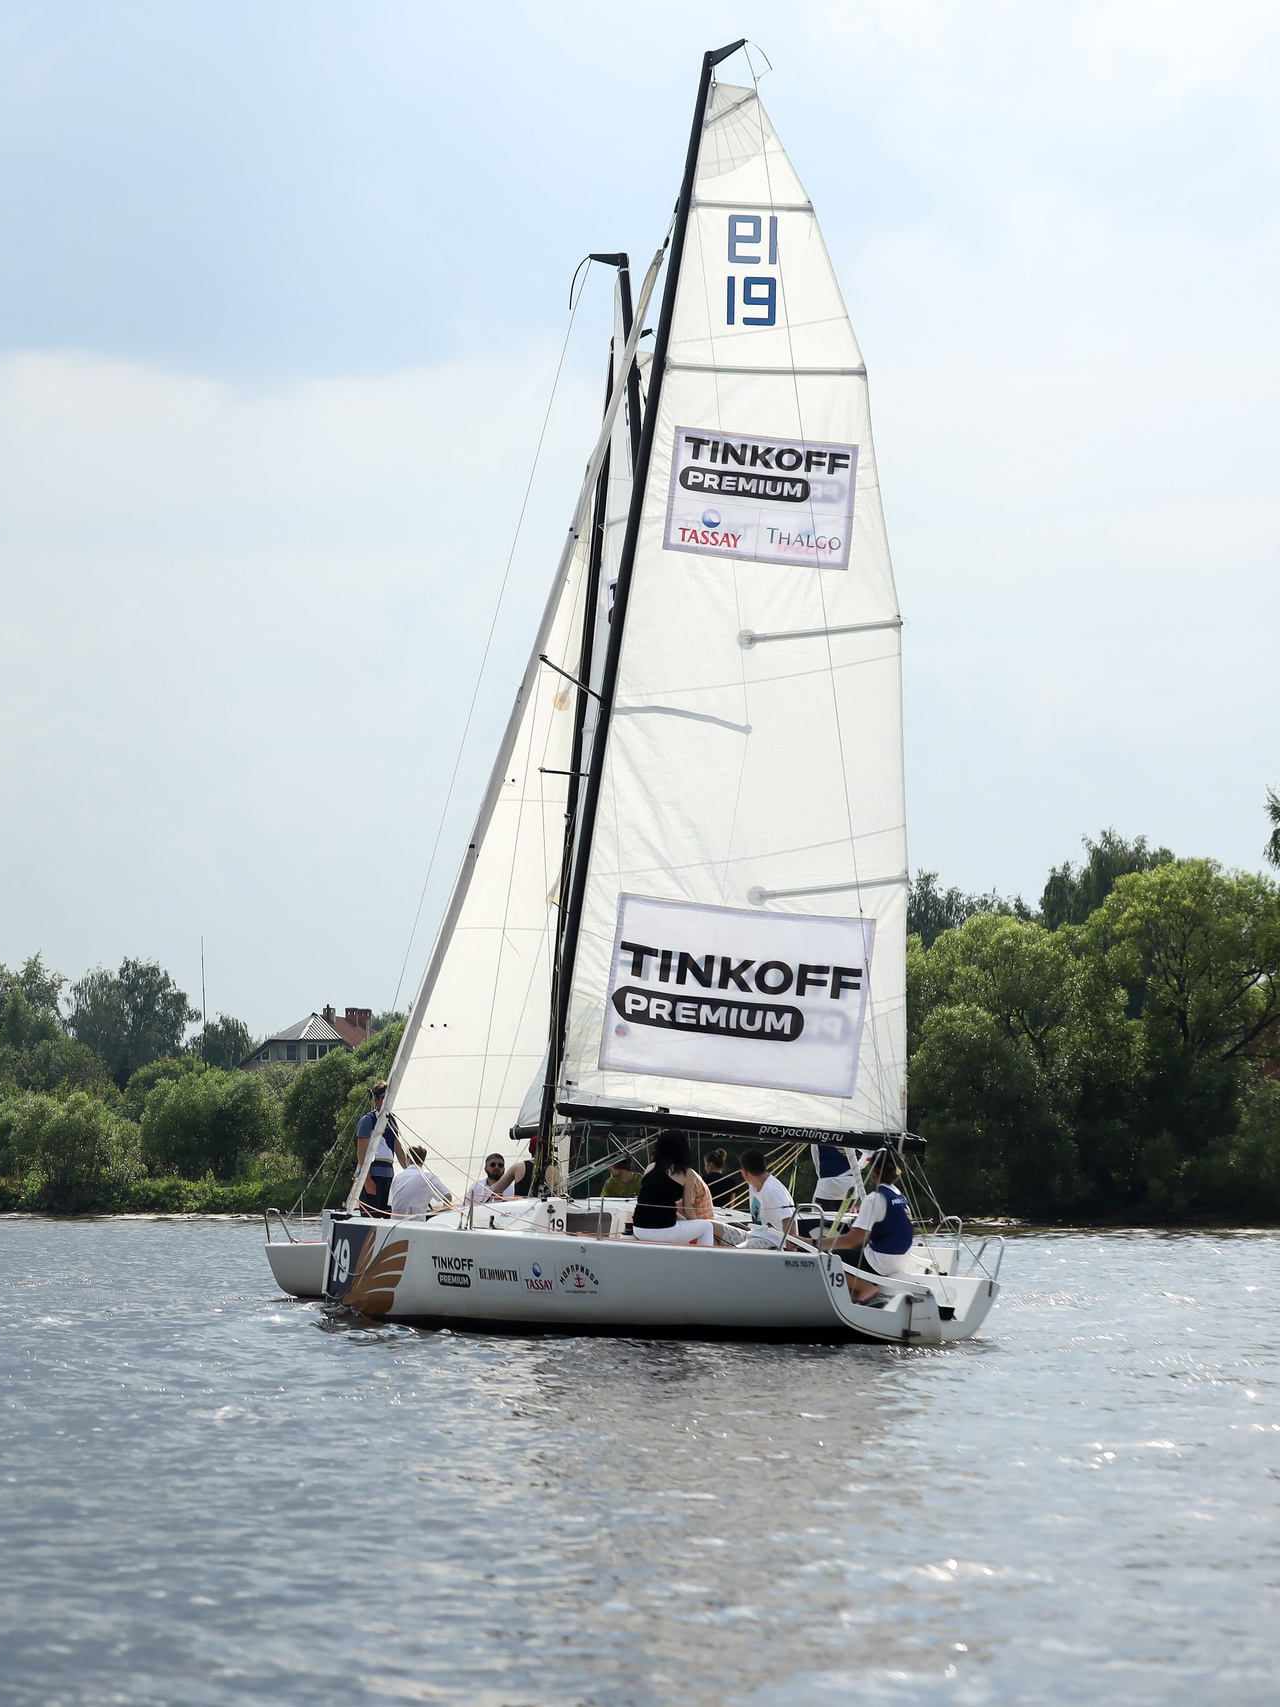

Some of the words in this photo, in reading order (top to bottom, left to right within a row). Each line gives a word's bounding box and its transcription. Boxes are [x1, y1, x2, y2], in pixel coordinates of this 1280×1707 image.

[726, 276, 777, 326] 19
[684, 436, 851, 475] TINKOFF
[687, 470, 804, 498] PREMIUM
[678, 527, 742, 549] TASSAY
[766, 527, 842, 551] THALGO
[621, 940, 863, 1000] TINKOFF
[624, 992, 793, 1035] PREMIUM
[759, 1125, 844, 1142] pro-yachting.ru
[549, 1218, 564, 1232] 19
[332, 1238, 351, 1283] 19
[432, 1255, 474, 1271] TINKOFF
[784, 1260, 799, 1268] RUS
[439, 1273, 470, 1286] PREMIUM
[524, 1278, 553, 1291] TASSAY
[828, 1272, 845, 1288] 19
